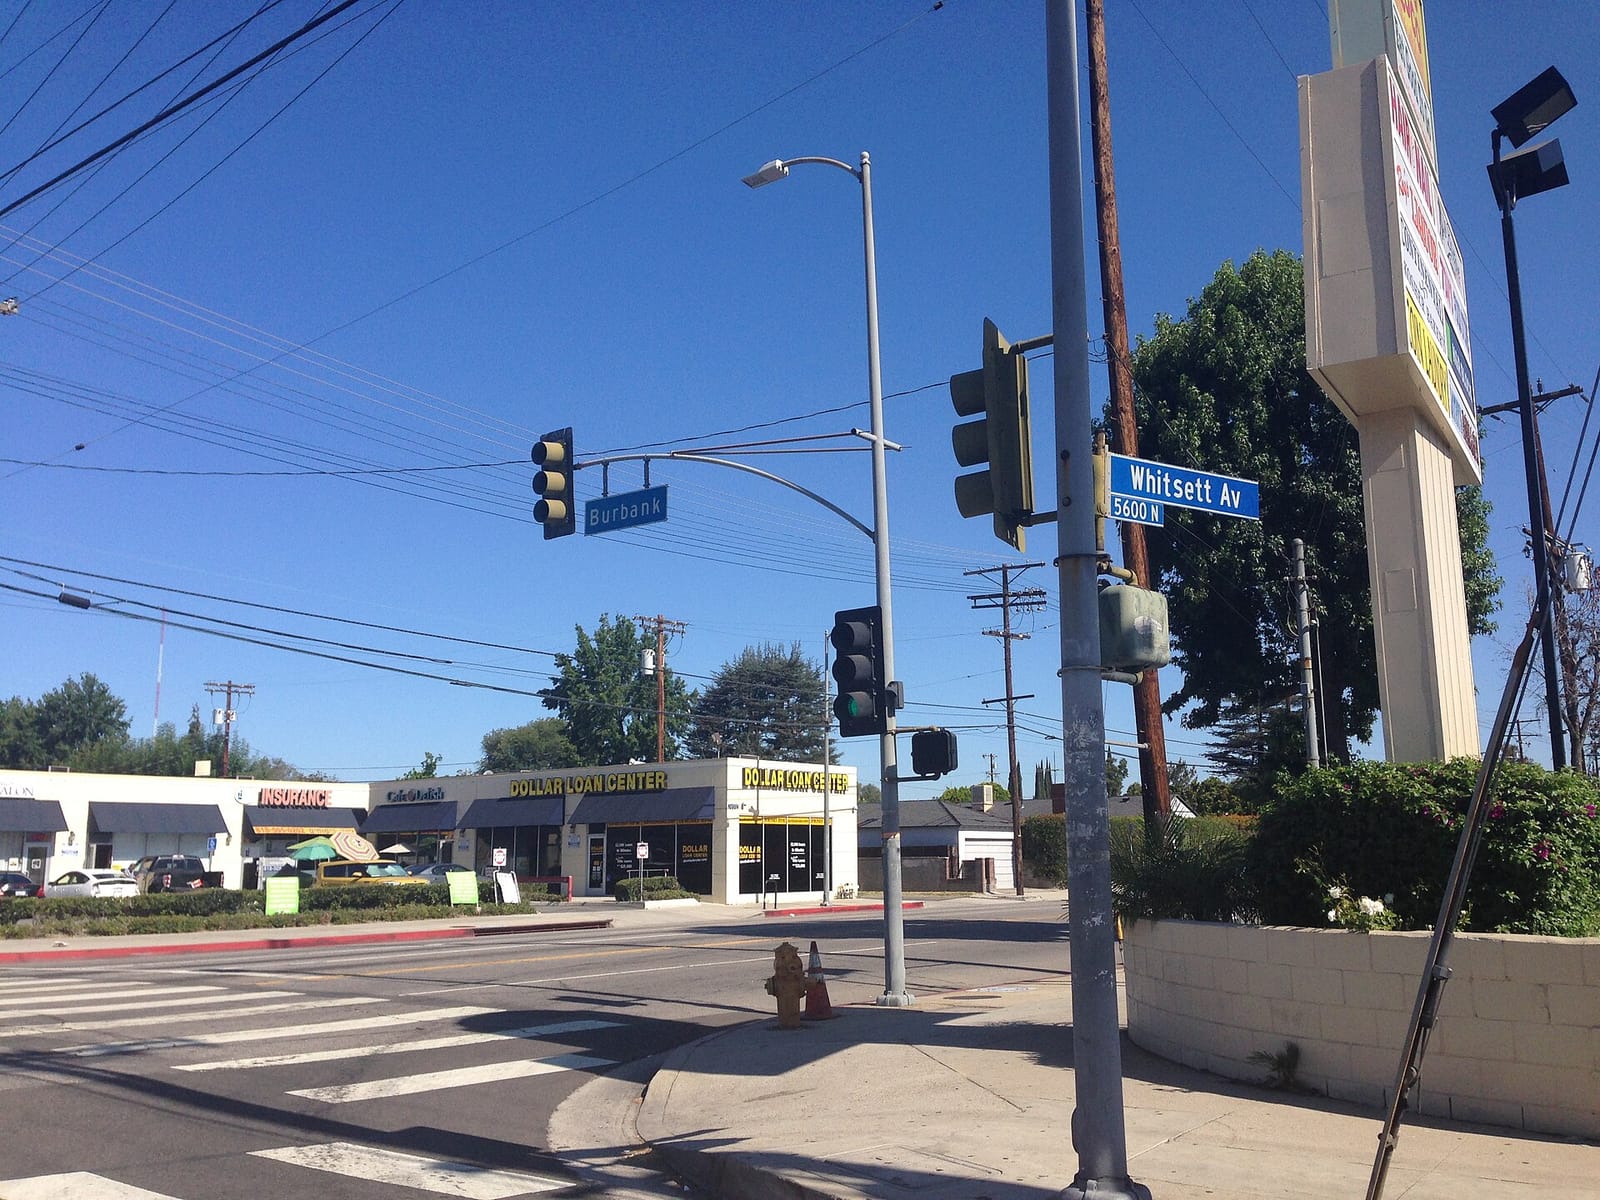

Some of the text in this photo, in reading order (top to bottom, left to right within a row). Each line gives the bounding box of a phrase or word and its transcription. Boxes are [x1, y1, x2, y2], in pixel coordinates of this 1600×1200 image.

[1130, 464, 1241, 509] Whitsett Av
[590, 497, 660, 526] Burbank
[1114, 498, 1159, 522] 5600 N
[510, 770, 667, 797] DOLLAR LOAN CENTER
[744, 767, 784, 787] DOLLAR
[786, 770, 811, 789] LOAN
[260, 787, 333, 807] INSURANCE
[682, 844, 708, 853] DOLLAR
